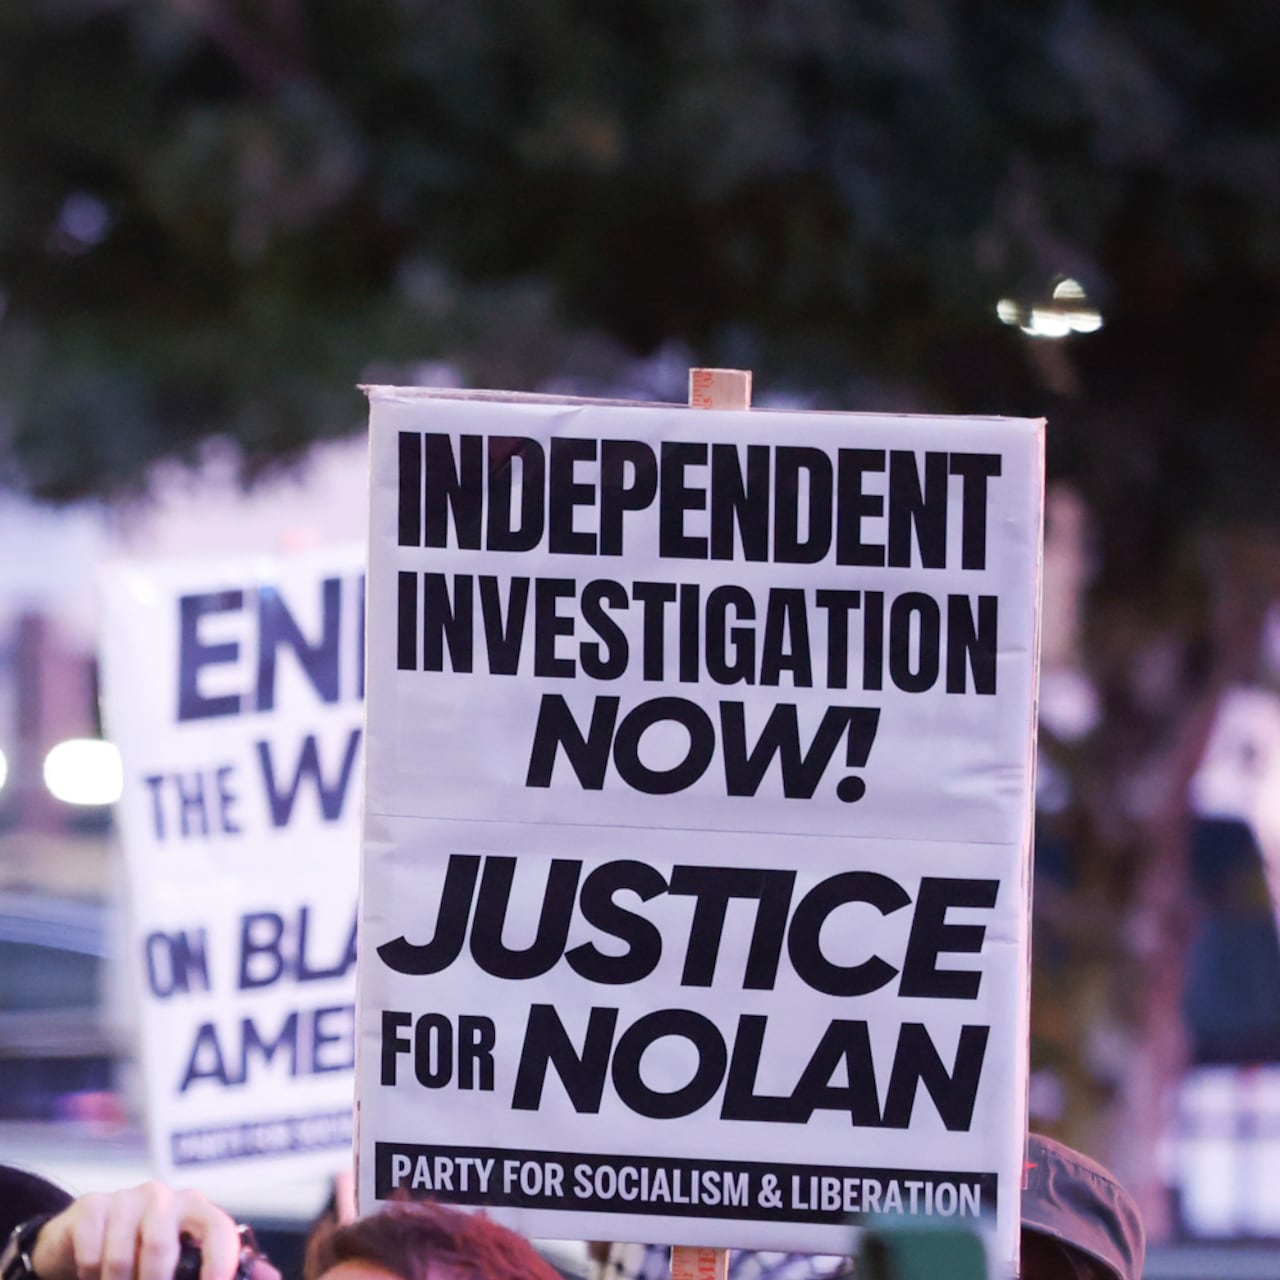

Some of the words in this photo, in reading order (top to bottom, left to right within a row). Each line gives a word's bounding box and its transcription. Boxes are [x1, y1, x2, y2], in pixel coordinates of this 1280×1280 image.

[397, 431, 1002, 571] INDEPENDENT
[176, 575, 365, 722] EN
[397, 571, 999, 696] INVESTIGATION
[144, 766, 240, 843] THE
[525, 693, 882, 804] NOW!
[145, 928, 210, 998] ON
[376, 853, 1001, 1000] JUSTICE
[380, 1010, 497, 1091] FOR
[511, 1003, 991, 1132] NOLAN
[390, 1153, 496, 1194] PARTY
[503, 1159, 565, 1197] FOR
[574, 1164, 750, 1207] SOCIALISM
[757, 1173, 783, 1209] &
[790, 1175, 982, 1218] LIBERATION
